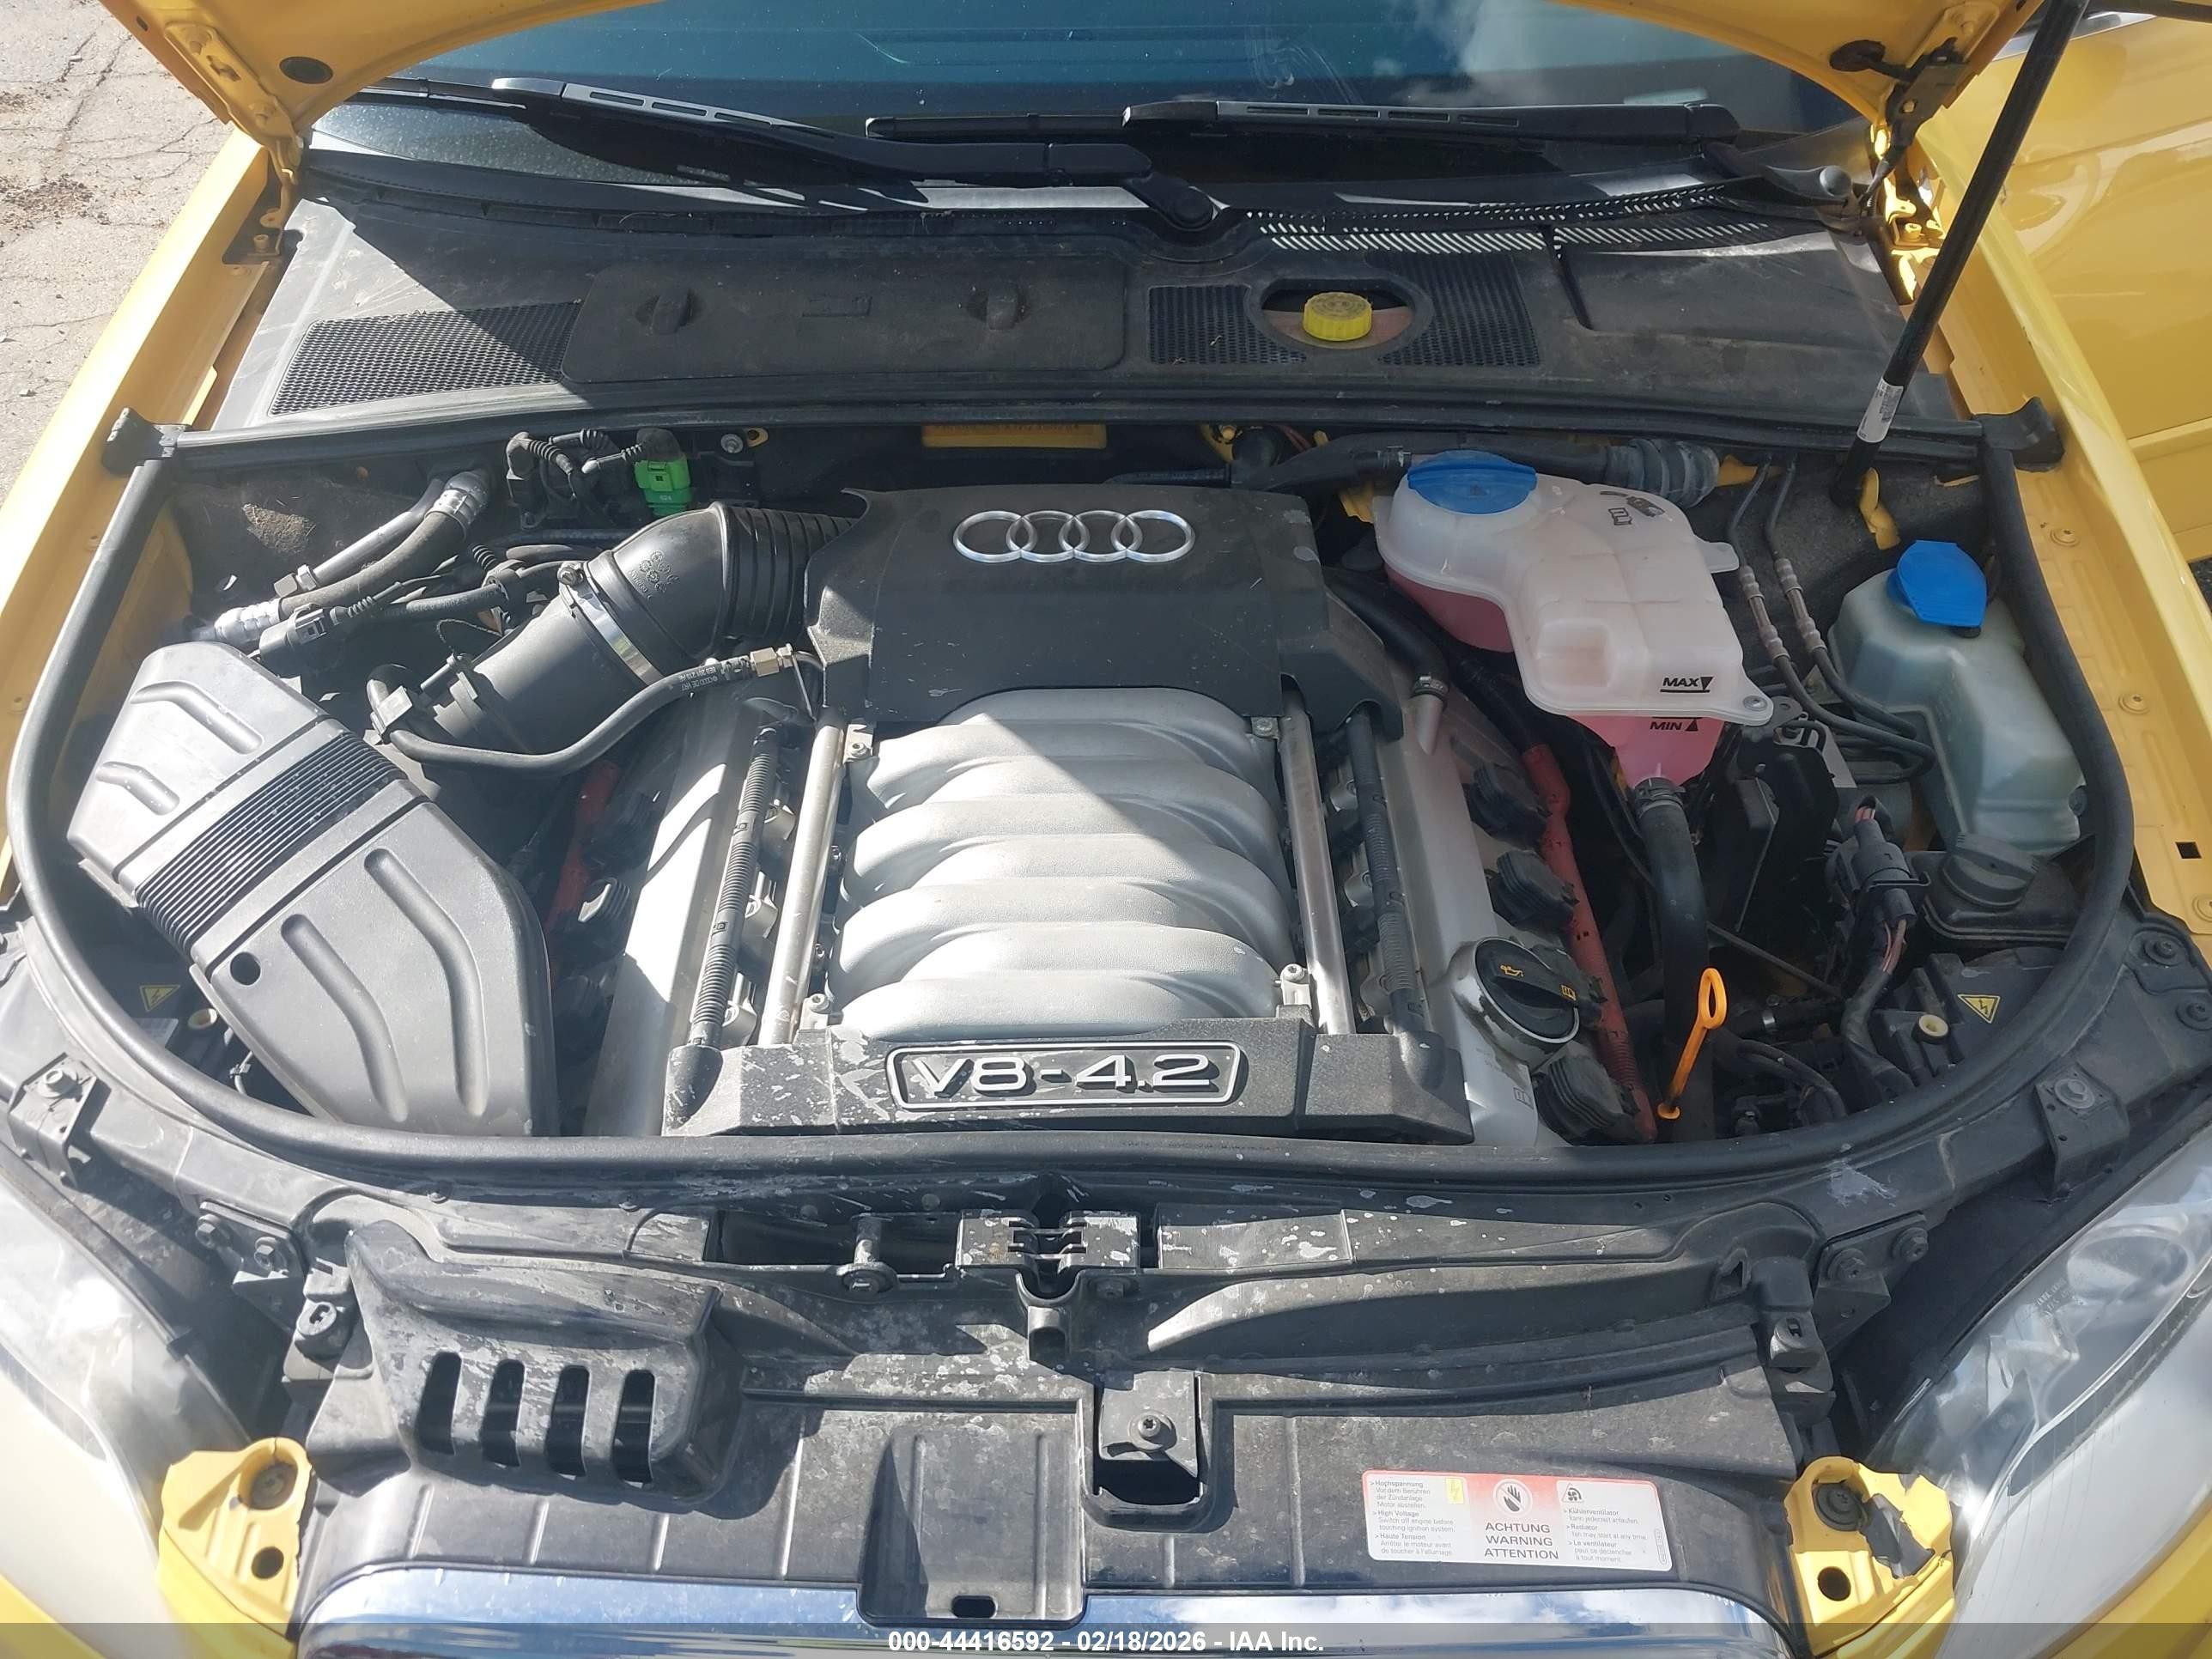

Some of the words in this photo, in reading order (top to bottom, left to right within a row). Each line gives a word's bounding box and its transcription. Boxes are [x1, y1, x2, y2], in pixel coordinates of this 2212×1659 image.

[1663, 678, 1699, 687] MAX
[1650, 722, 1682, 731] MIN
[1486, 1522, 1550, 1533] ACHTUNG
[1486, 1535, 1553, 1546] WARNING
[1485, 1548, 1559, 1559] ATTENTION
